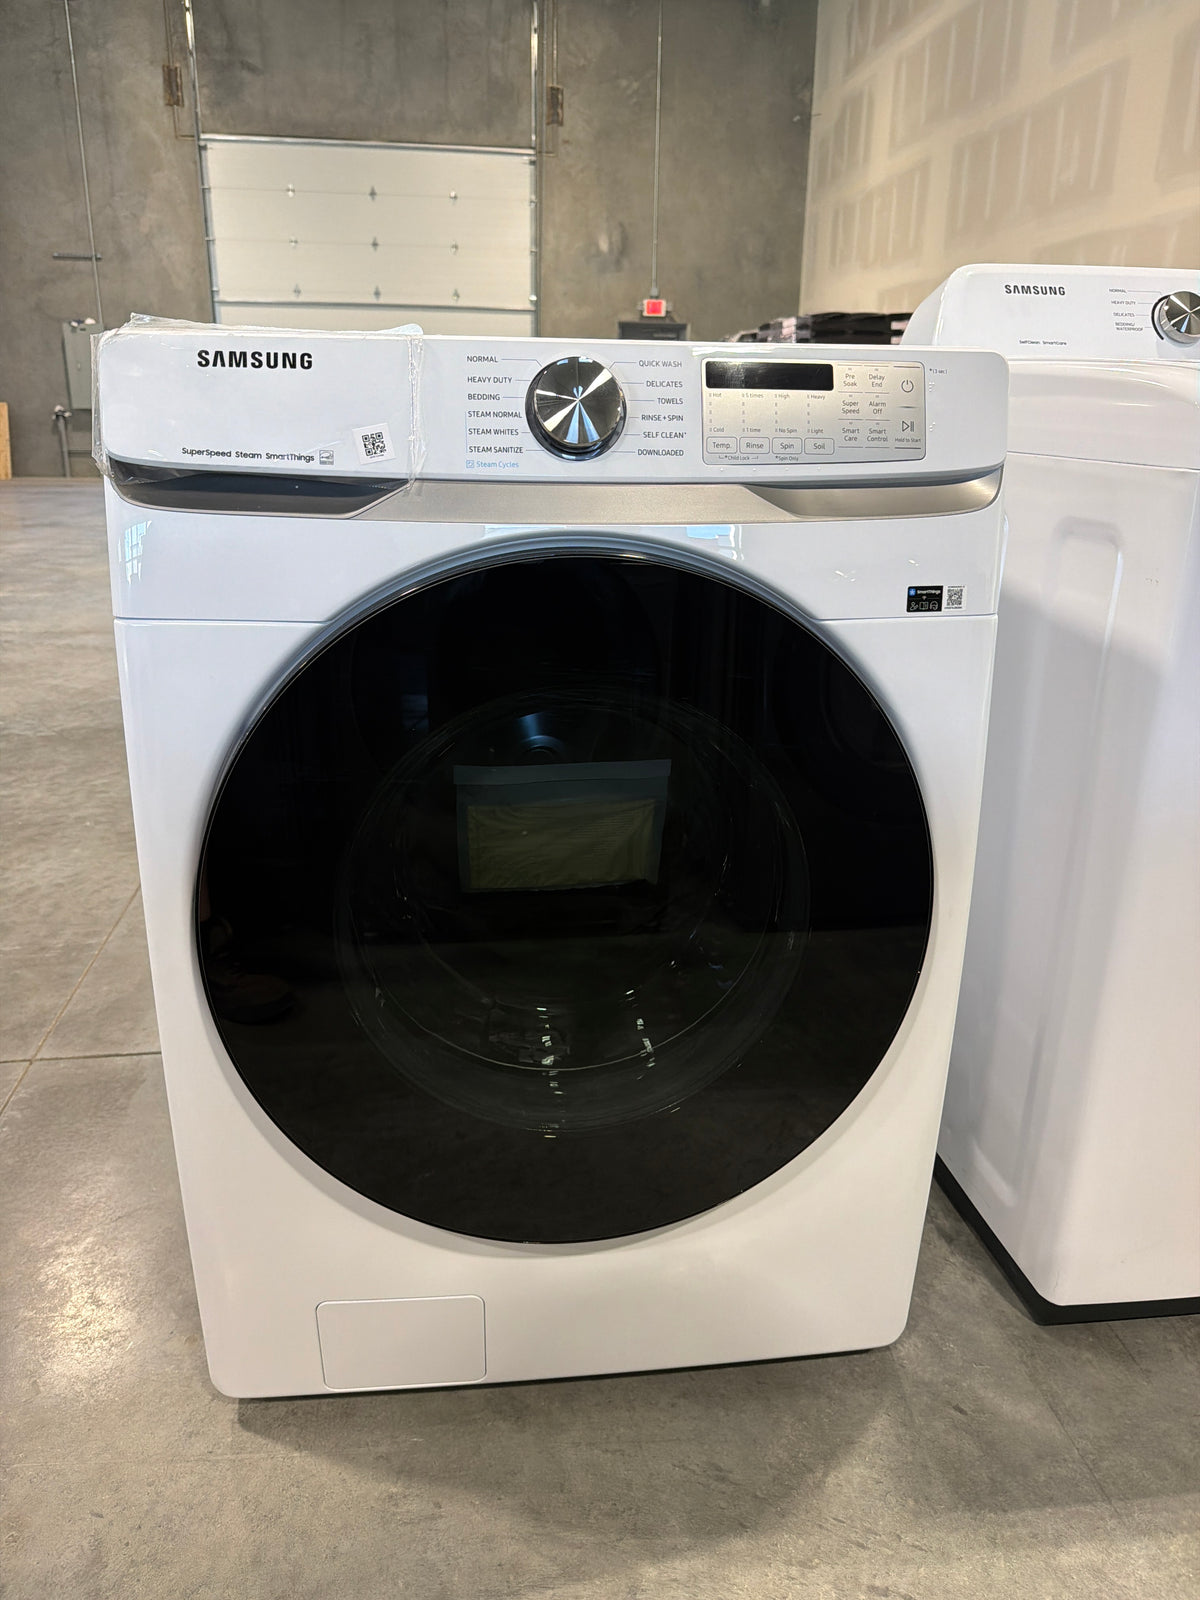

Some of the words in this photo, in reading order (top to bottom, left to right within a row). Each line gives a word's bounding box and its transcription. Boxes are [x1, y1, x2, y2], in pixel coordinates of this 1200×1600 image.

[1004, 284, 1066, 296] SAMSUNG
[197, 350, 313, 370] SAMSUNG
[638, 360, 660, 368] QUICK
[638, 448, 684, 456] DOWNLOADED
[780, 443, 794, 451] Spin
[182, 447, 232, 458] SuperSpeed
[235, 450, 262, 460] Steam
[266, 452, 314, 462] SmartThings
